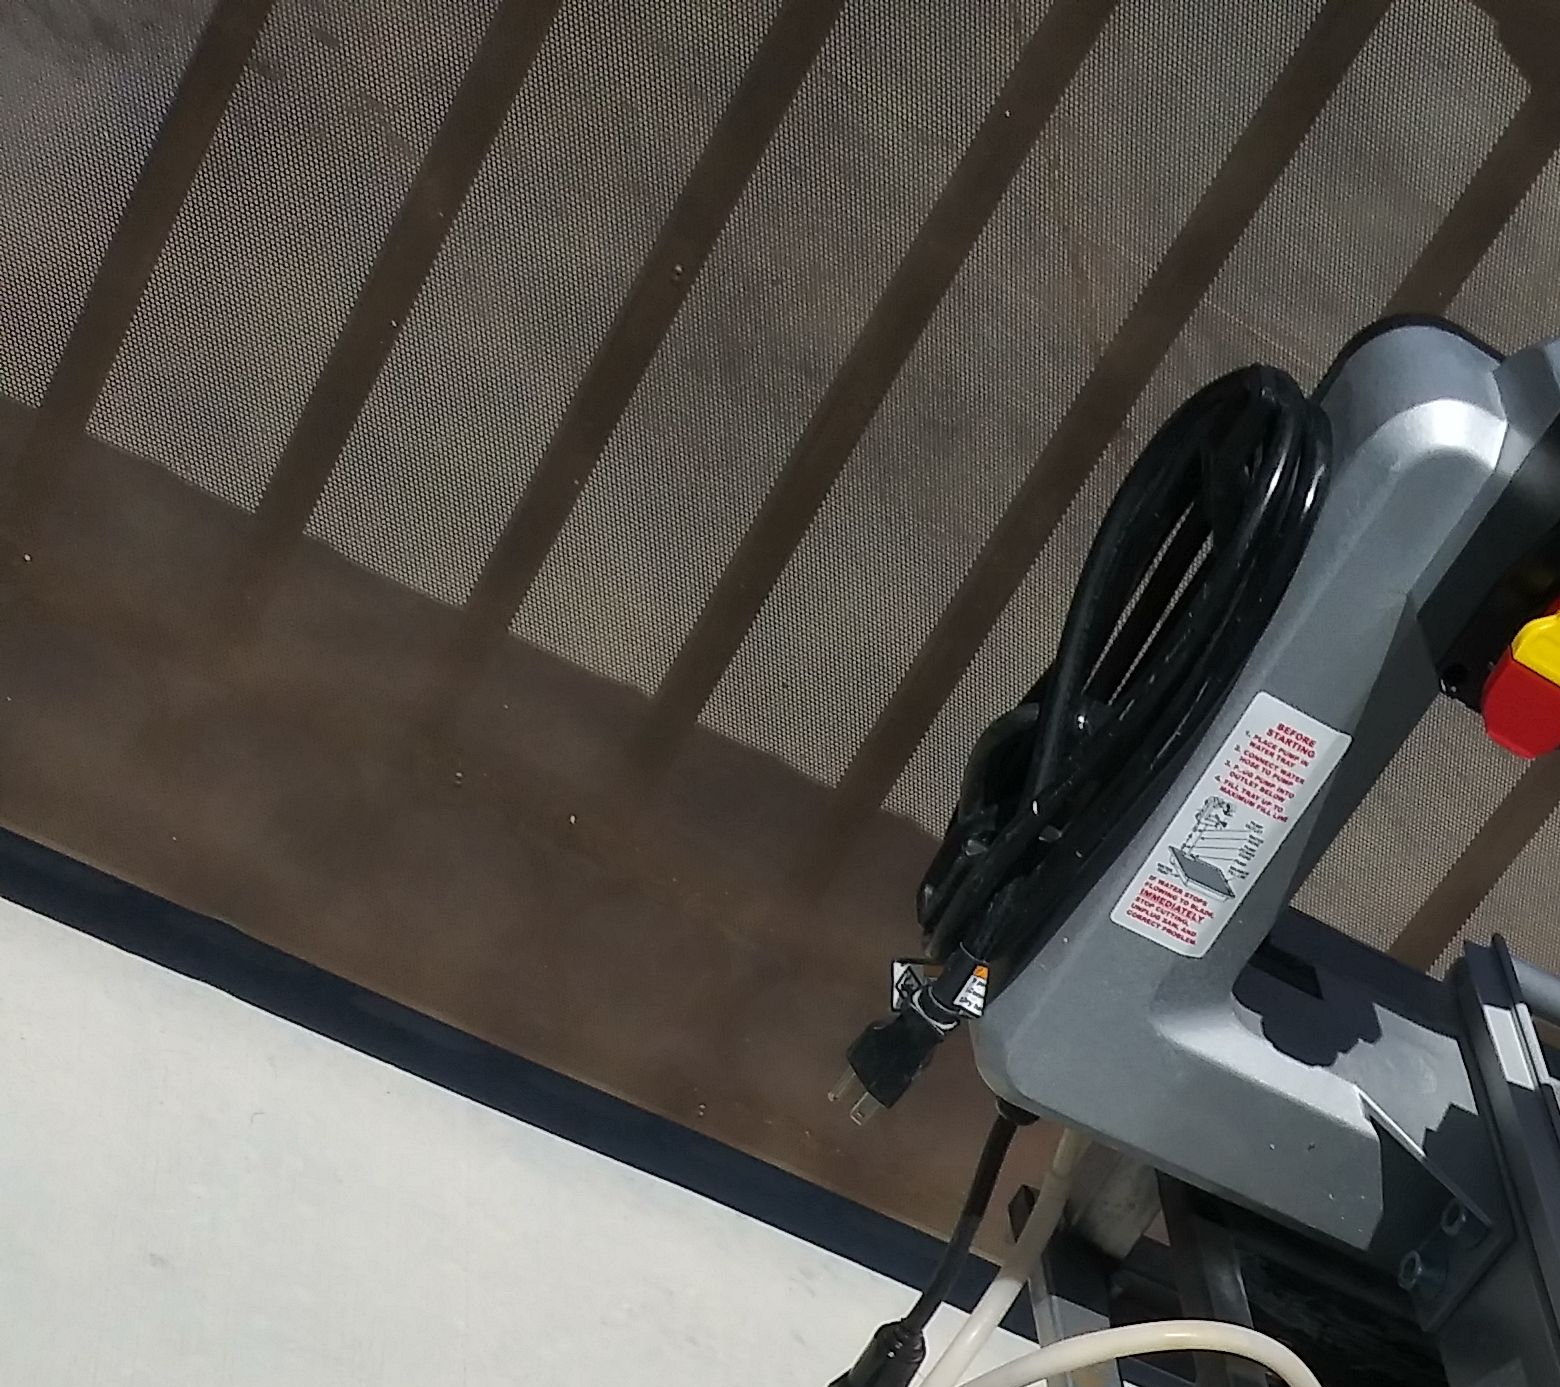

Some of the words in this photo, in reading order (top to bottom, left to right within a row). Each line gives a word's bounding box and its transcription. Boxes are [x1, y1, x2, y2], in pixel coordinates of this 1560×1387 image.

[1266, 728, 1316, 758] STARTING
[1277, 723, 1316, 748] BEFORE
[1243, 750, 1279, 770] CONNECT
[1280, 768, 1306, 785] WATER
[1140, 888, 1205, 924] IMMEDIATELY
